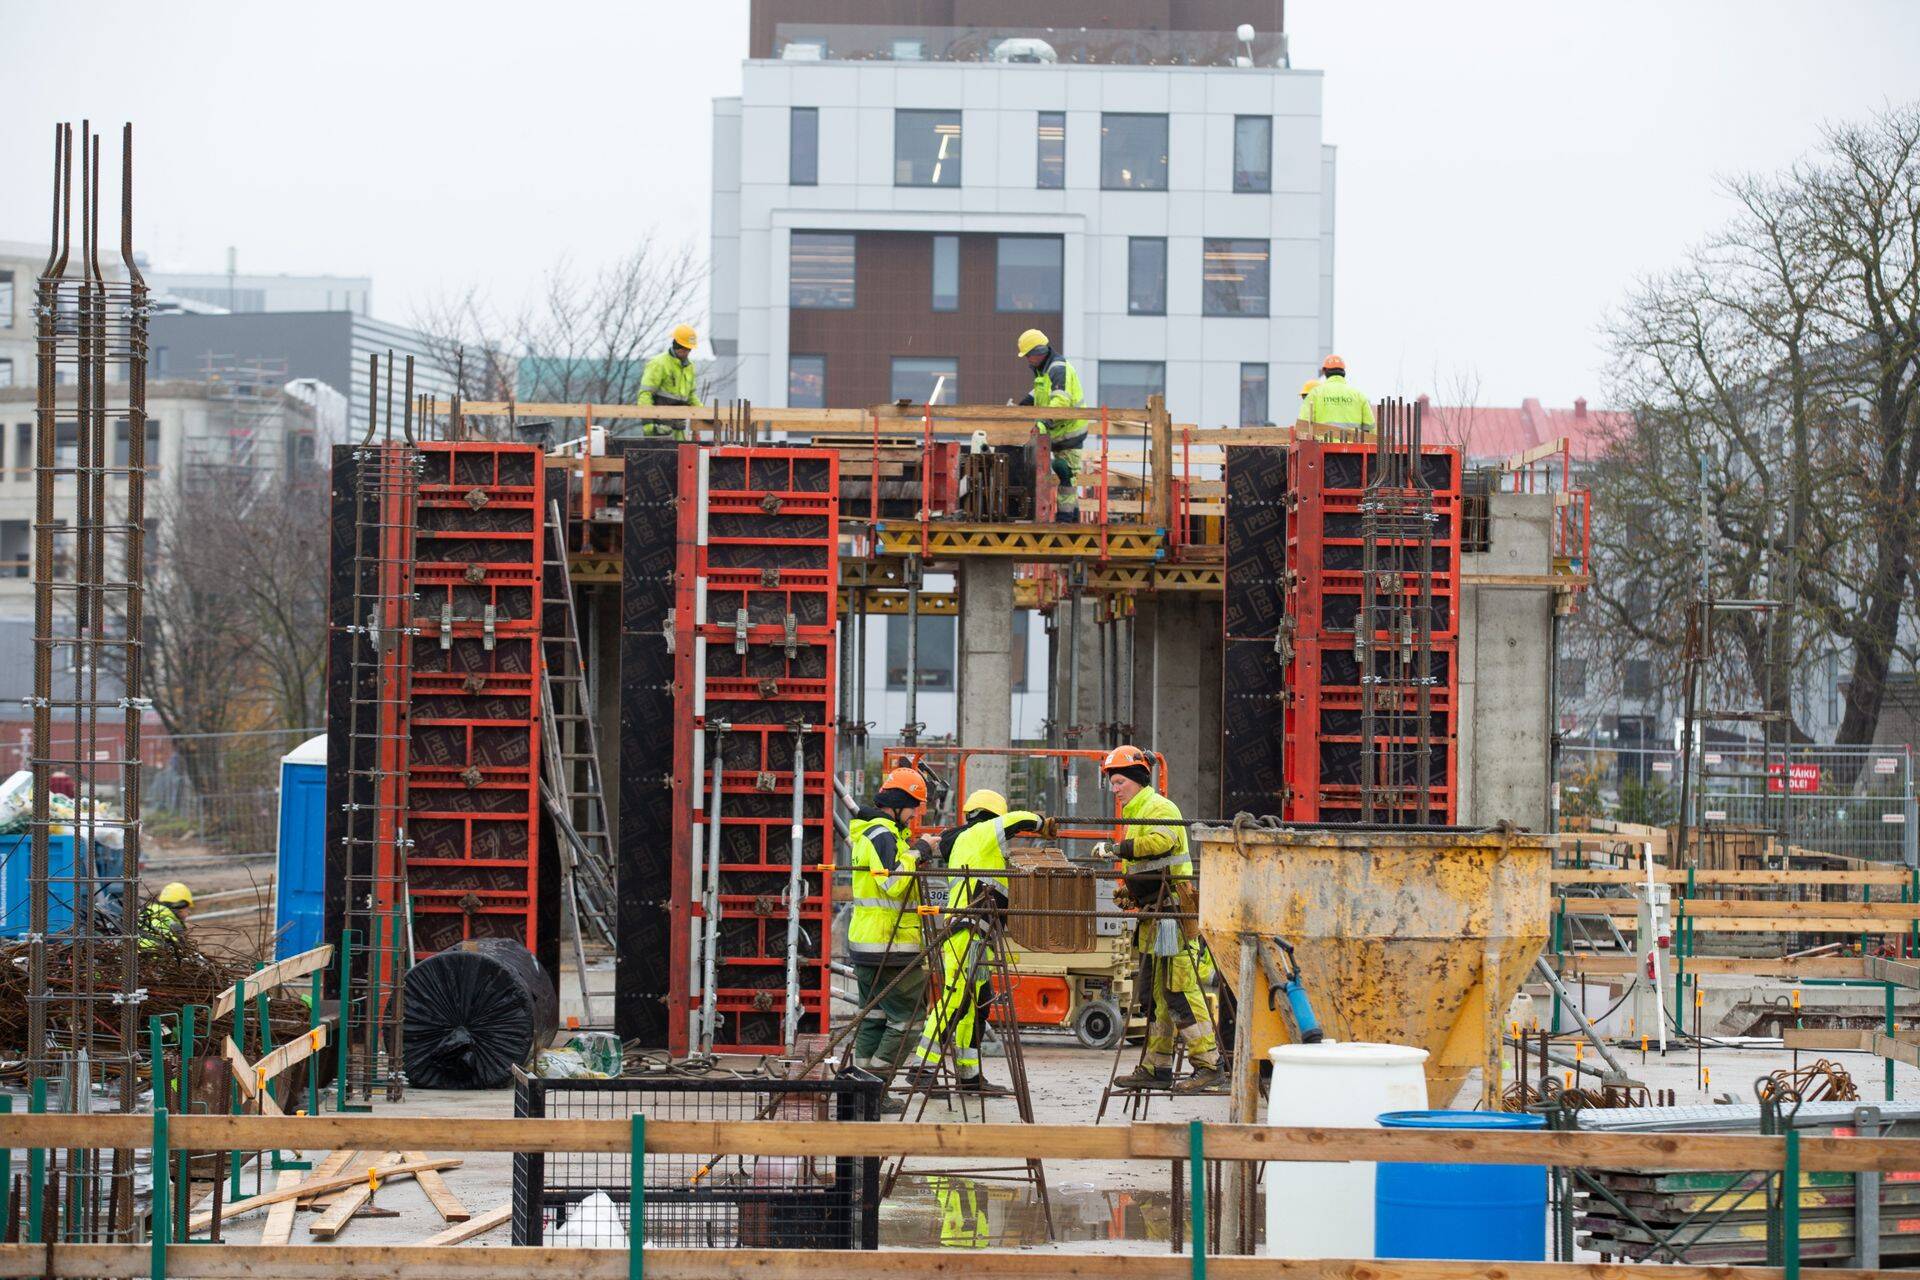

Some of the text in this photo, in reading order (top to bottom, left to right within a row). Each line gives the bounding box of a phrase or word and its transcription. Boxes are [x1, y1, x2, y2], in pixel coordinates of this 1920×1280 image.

[1323, 395, 1352, 403] merko
[644, 468, 667, 497] PERI
[1231, 473, 1255, 503] PERI
[635, 516, 656, 544] PERI
[1248, 507, 1278, 530] PERI
[643, 553, 671, 575] PERI
[1230, 562, 1259, 585] PERI
[627, 592, 655, 614] PERI
[1226, 603, 1244, 623] ERI
[1254, 589, 1276, 618] PERI
[462, 642, 483, 669] PERI
[501, 656, 519, 673] ERI
[430, 734, 450, 762] PERI
[500, 740, 529, 763] PERI
[770, 738, 788, 766] PERI
[1239, 744, 1266, 768] PERI
[471, 835, 494, 855] PER
[733, 831, 754, 860] PERI
